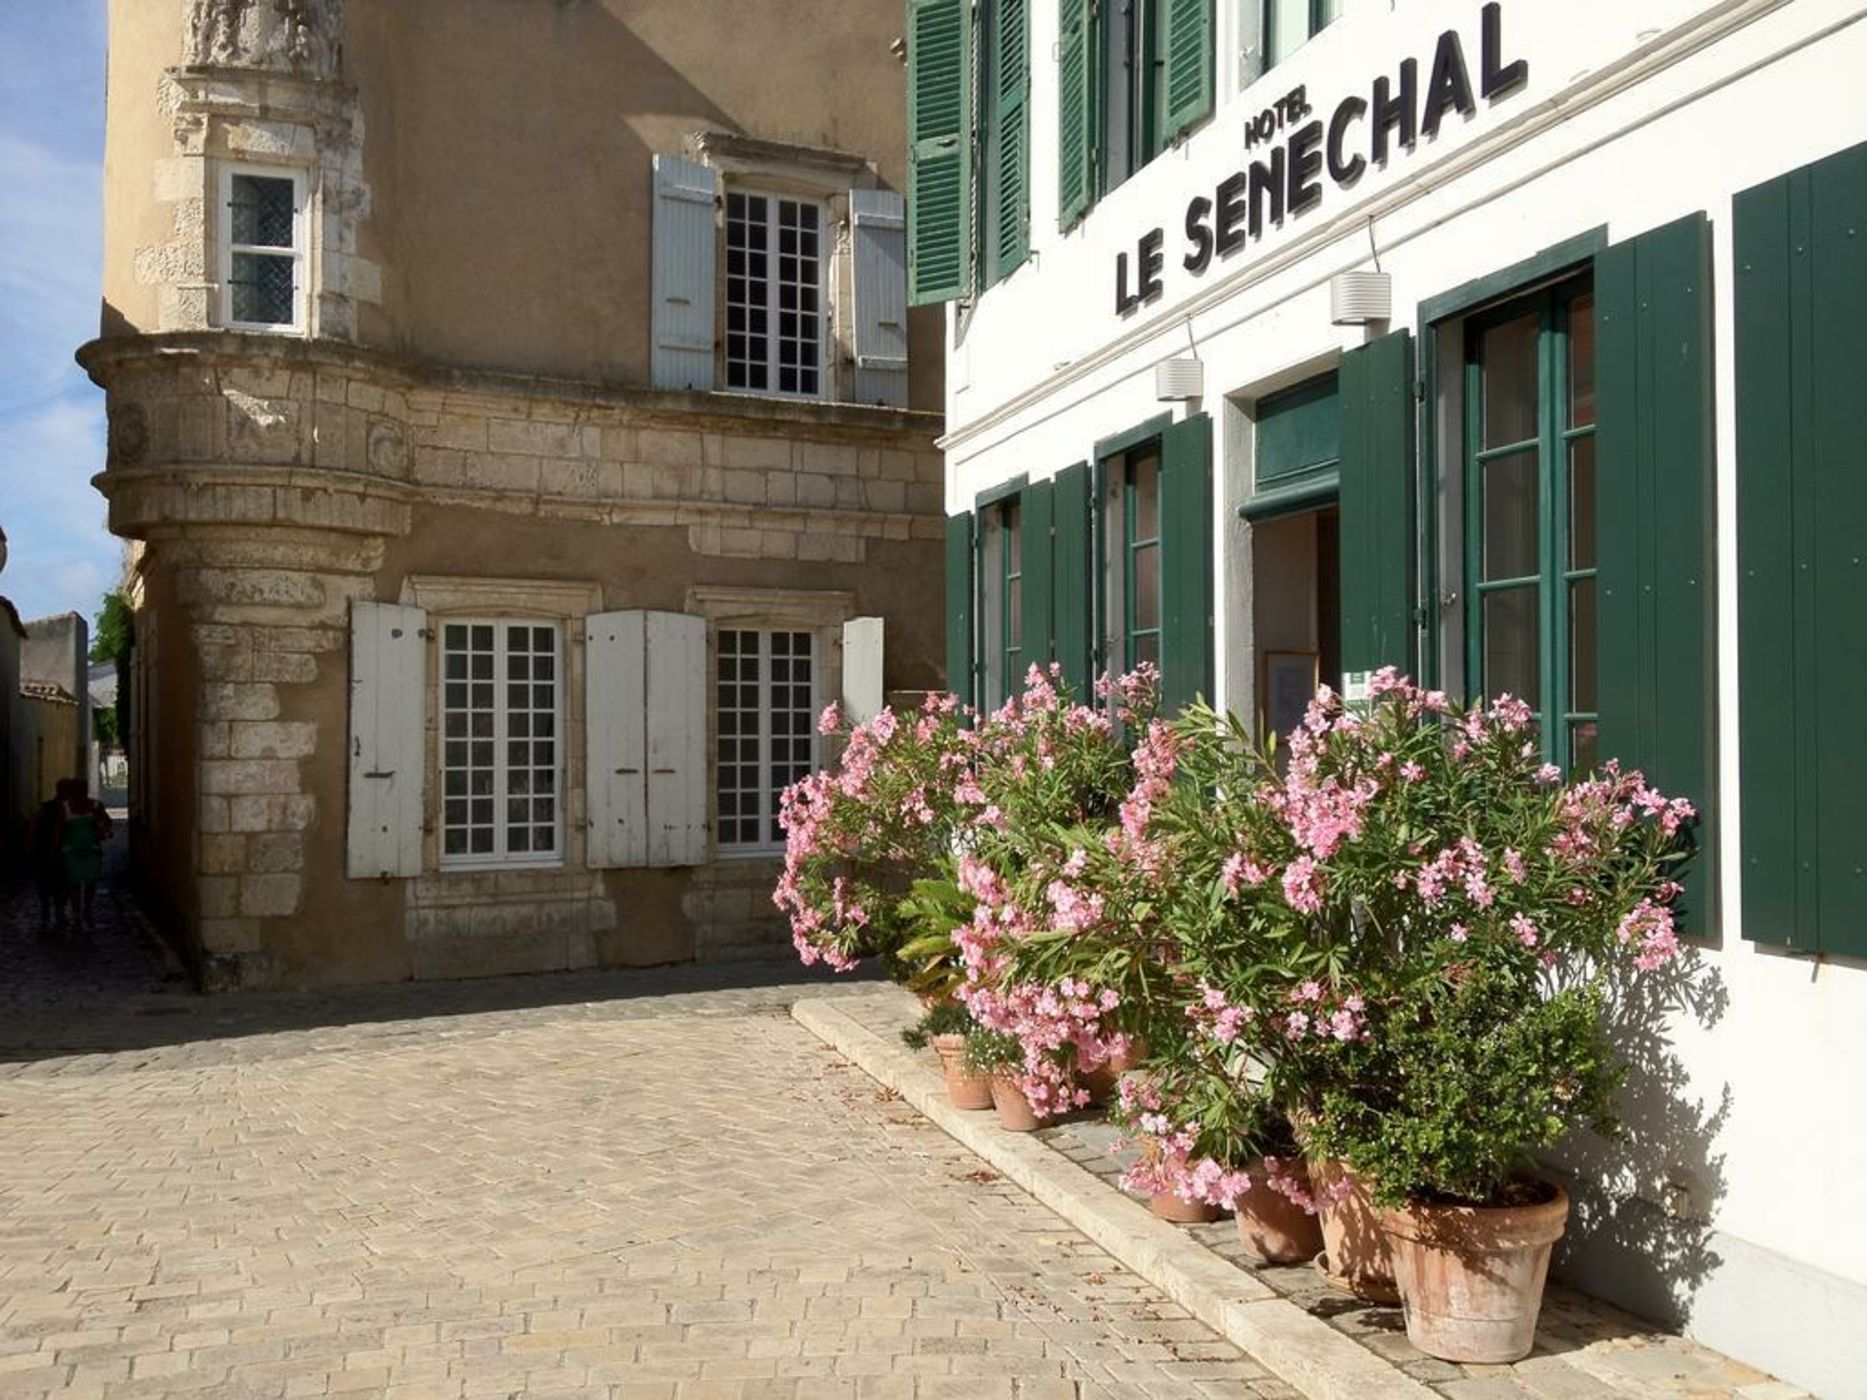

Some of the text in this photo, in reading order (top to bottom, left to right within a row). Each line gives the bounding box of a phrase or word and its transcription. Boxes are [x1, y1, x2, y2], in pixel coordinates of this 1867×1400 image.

[1116, 2, 1528, 319] LE SENECHAL
[1245, 84, 1311, 150] HOTEL
